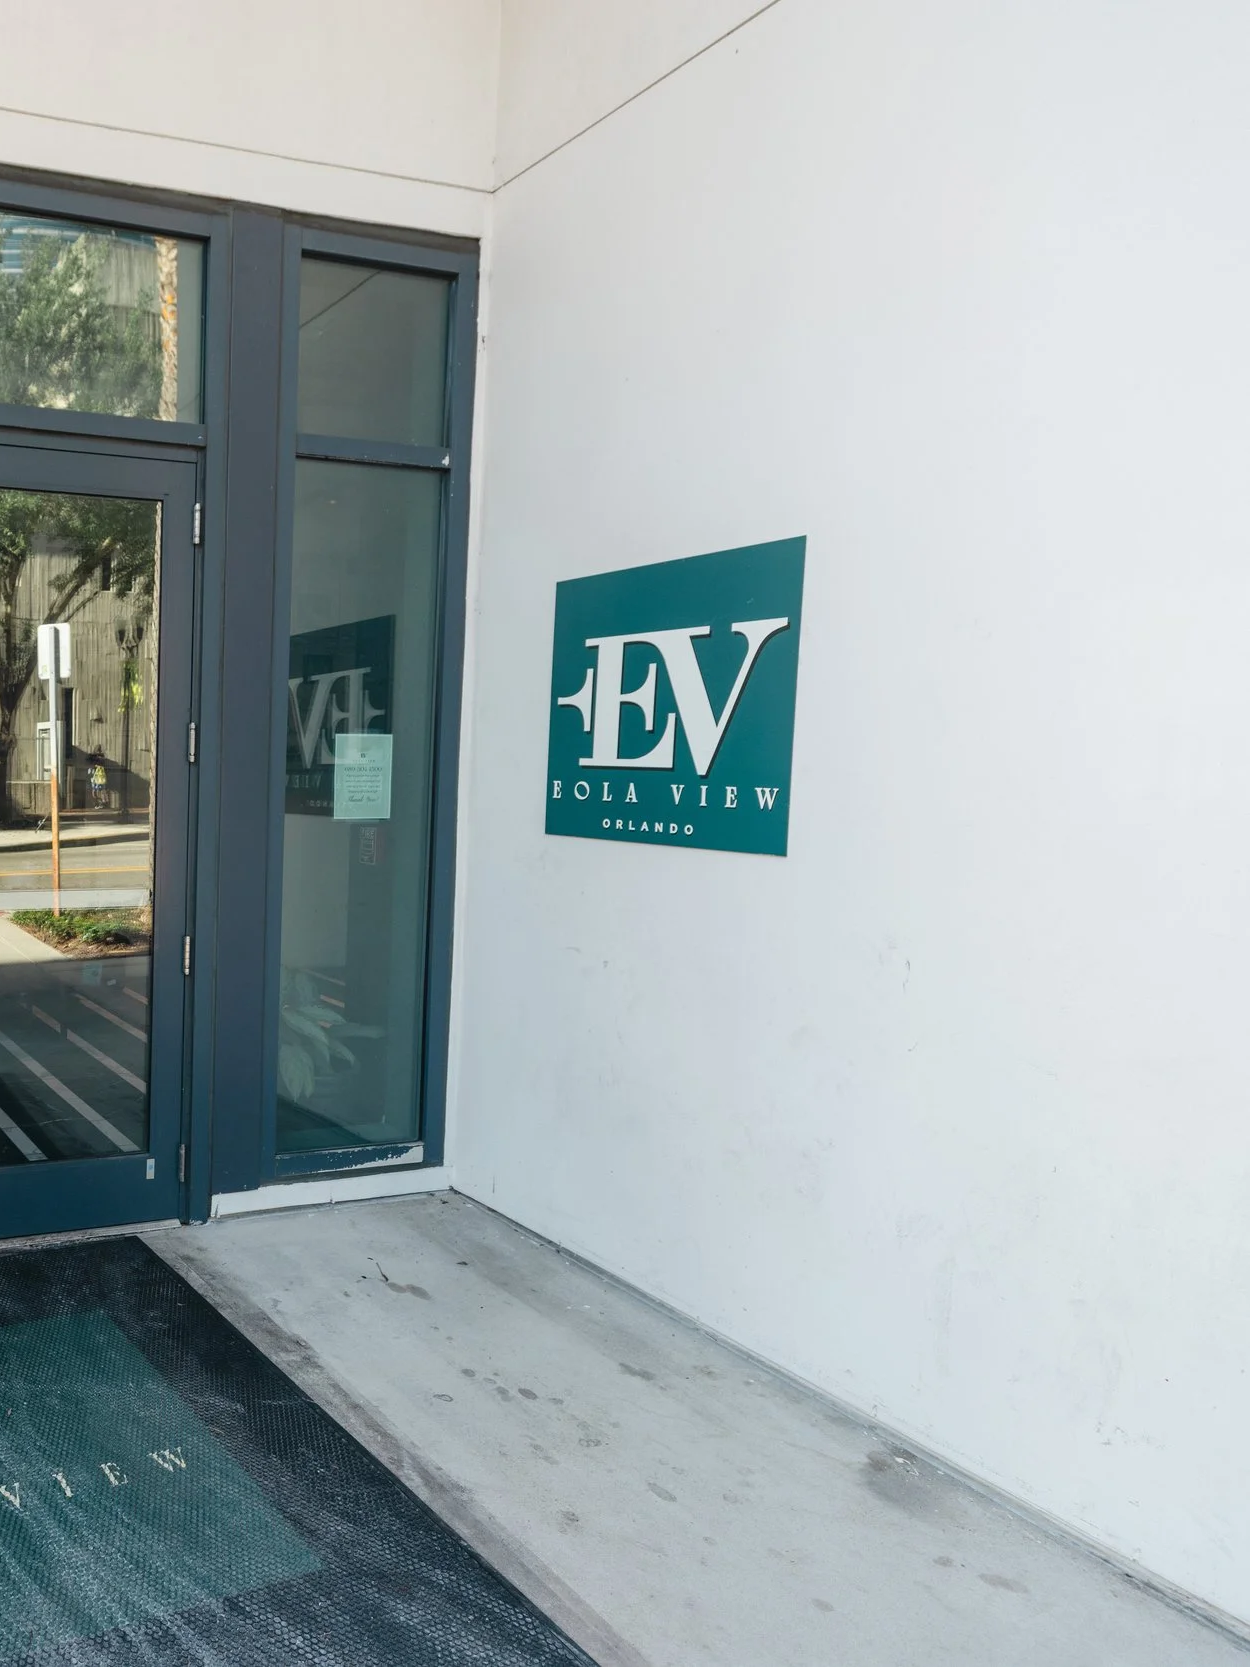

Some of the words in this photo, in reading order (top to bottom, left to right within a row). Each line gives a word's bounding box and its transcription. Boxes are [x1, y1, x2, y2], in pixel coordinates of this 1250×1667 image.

[553, 780, 639, 804] EOLA
[670, 784, 780, 811] VIEW
[602, 818, 696, 836] ORLANDO
